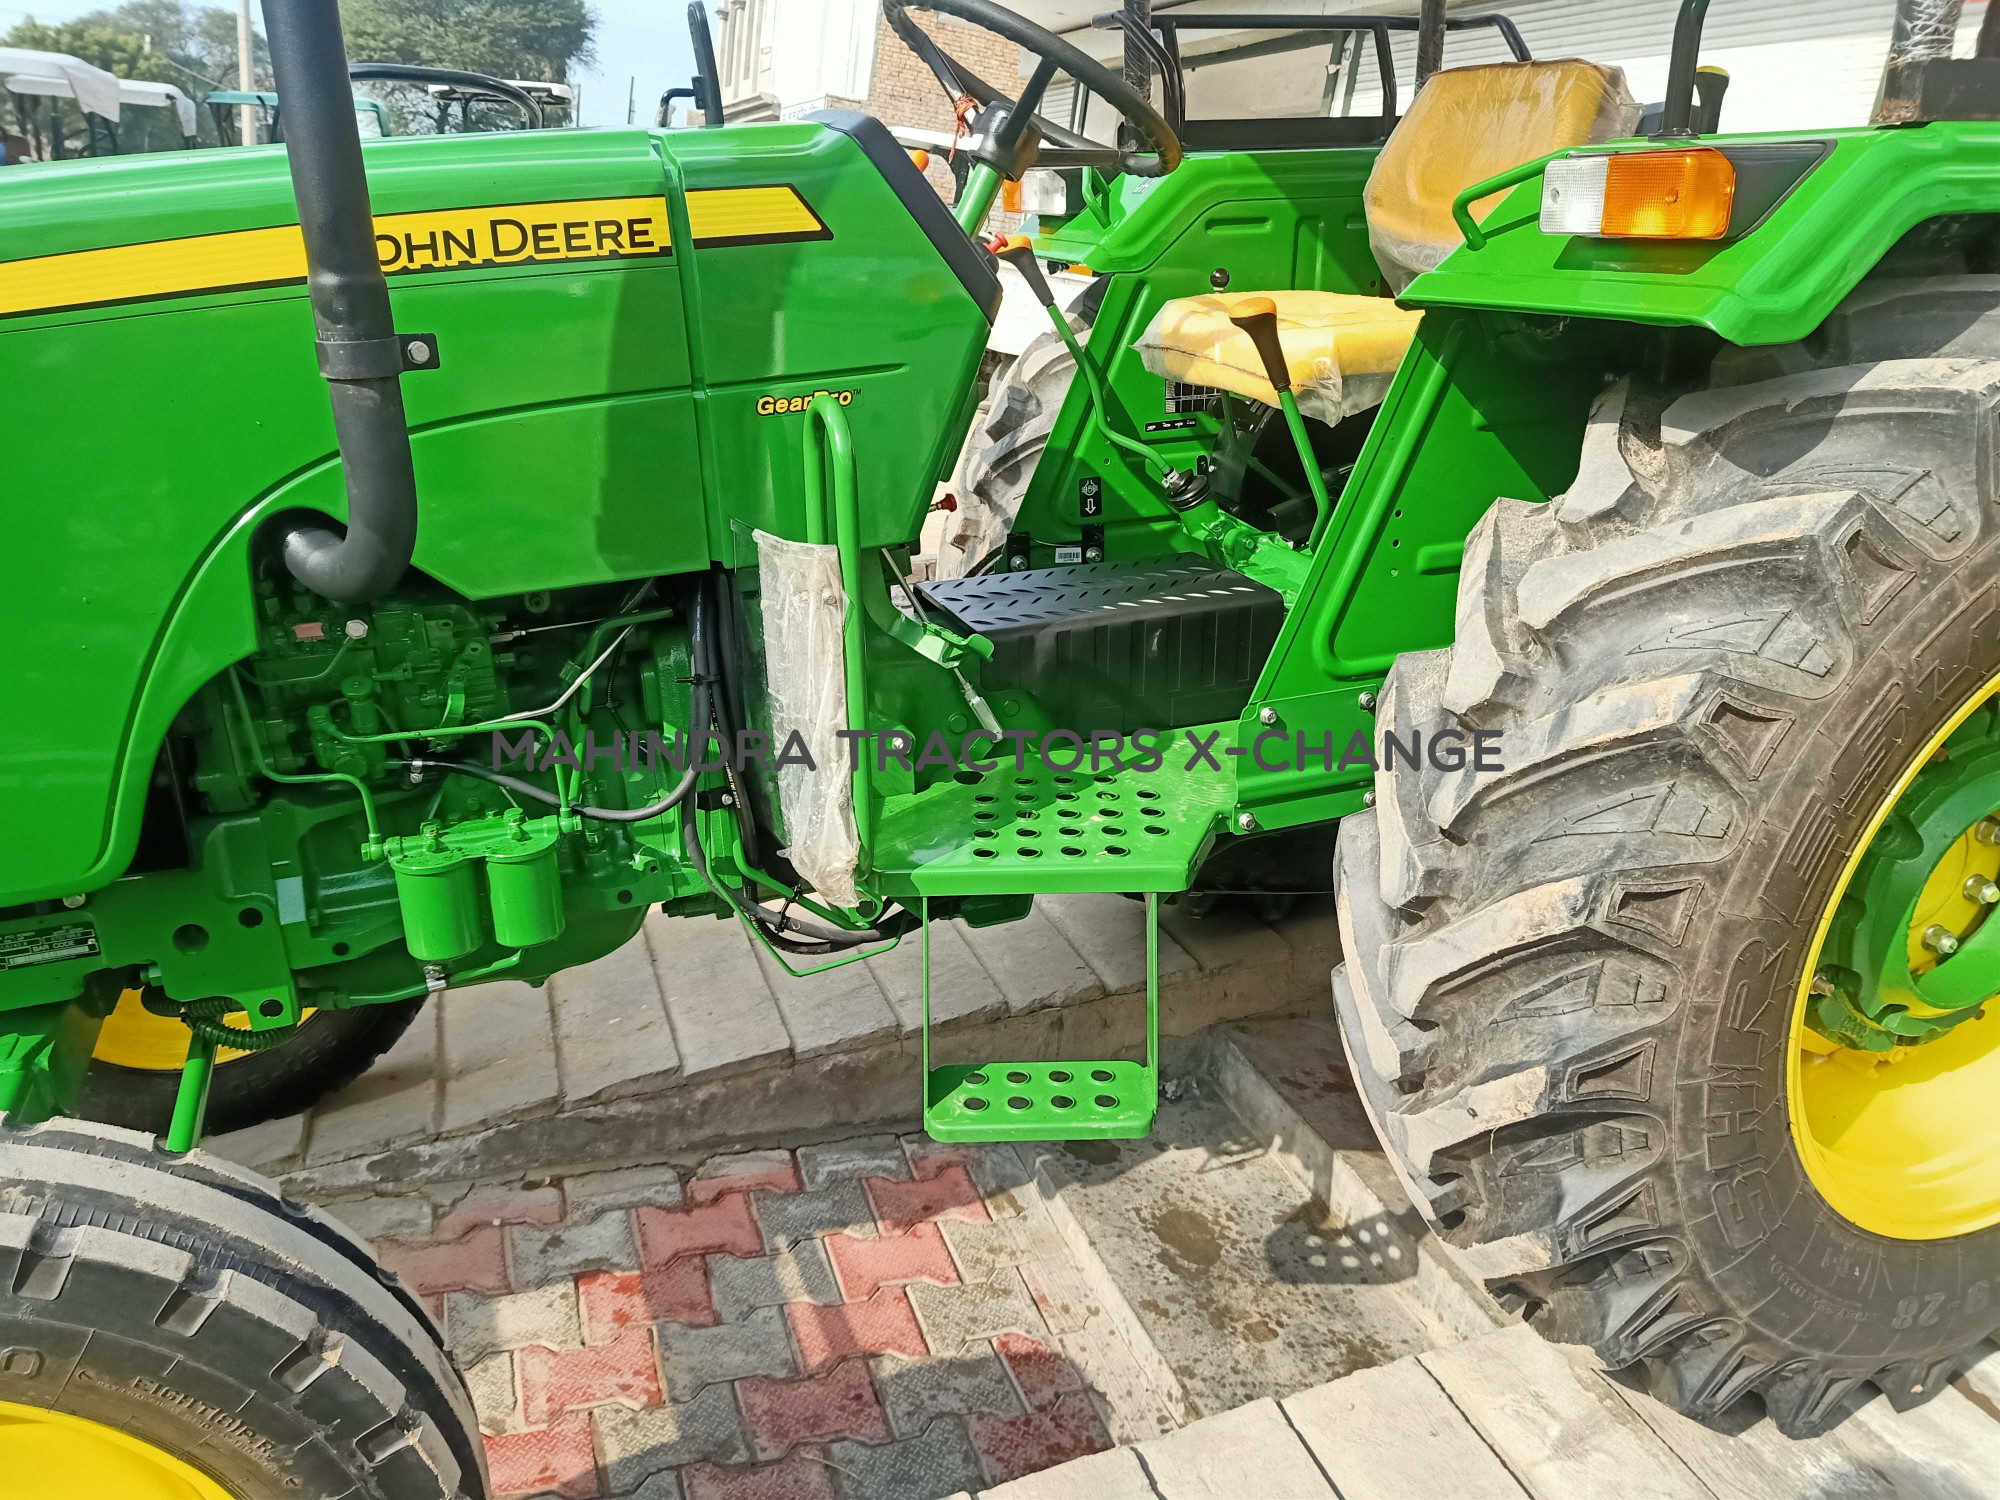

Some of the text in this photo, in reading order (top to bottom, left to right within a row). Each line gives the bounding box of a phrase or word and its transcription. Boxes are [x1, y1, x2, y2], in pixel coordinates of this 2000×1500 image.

[375, 218, 655, 267] OHN DEERE
[33, 944, 50, 952] BAR
